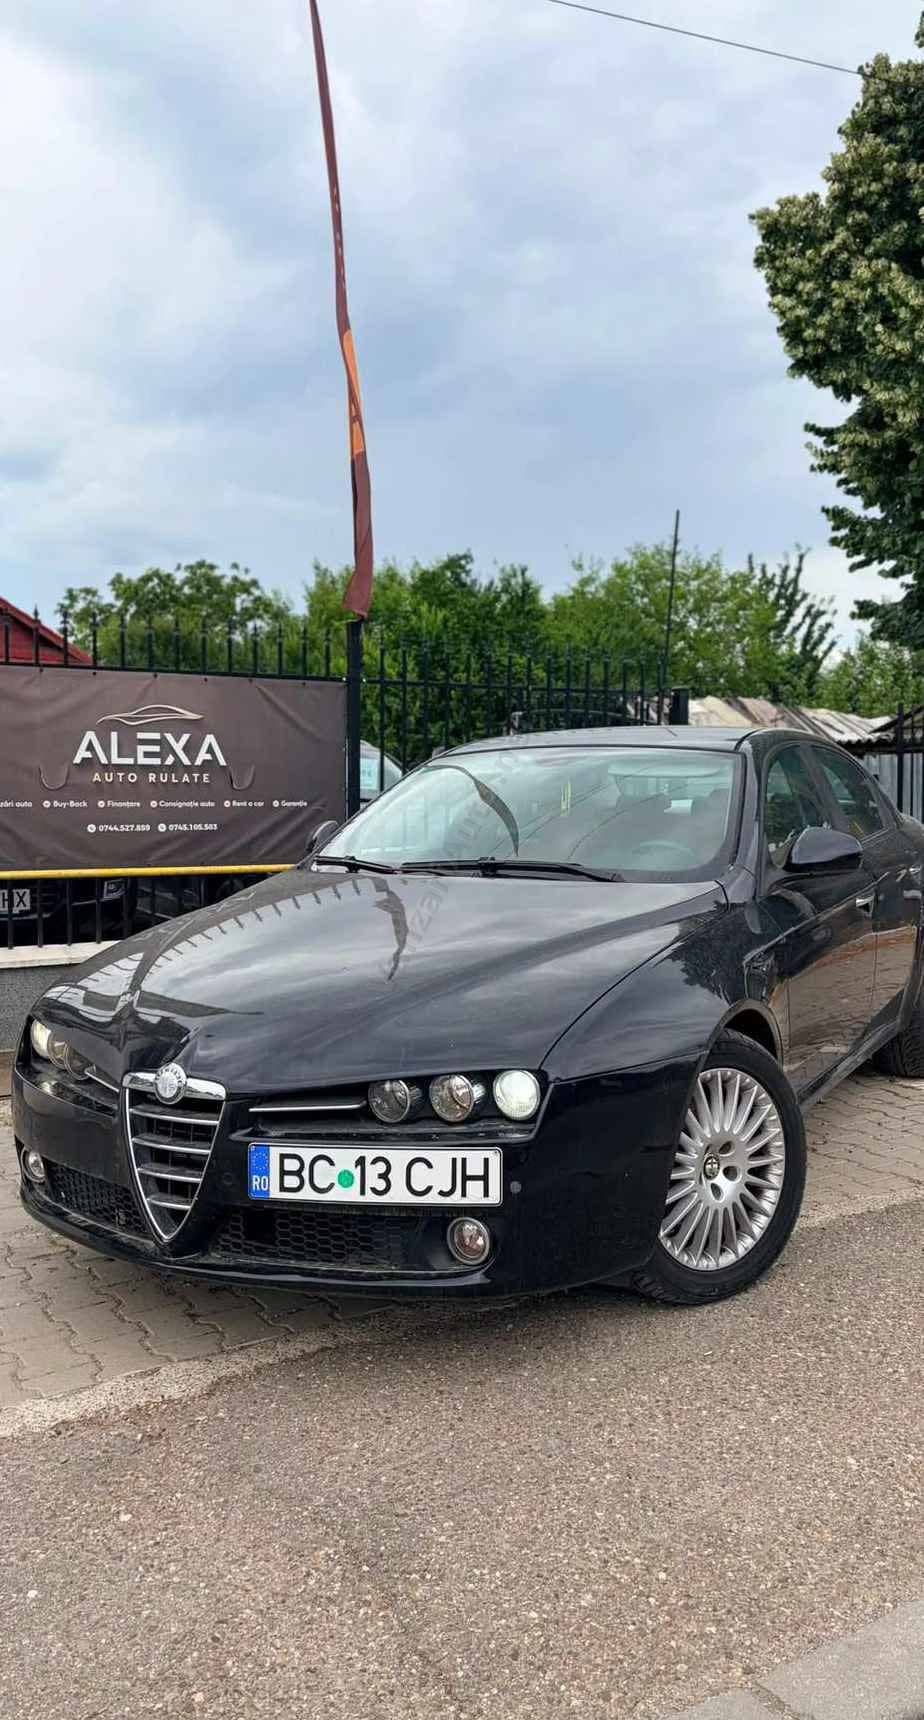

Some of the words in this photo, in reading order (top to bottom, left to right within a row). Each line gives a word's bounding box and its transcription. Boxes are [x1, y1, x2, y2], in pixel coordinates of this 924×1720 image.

[73, 731, 227, 766] ALEXA
[92, 772, 138, 783] AUTO
[149, 772, 210, 783] RULATE
[53, 800, 88, 809] Buy-Back
[252, 1175, 269, 1191] RO
[278, 1152, 336, 1194] BC
[354, 1155, 392, 1197] 13
[405, 1156, 490, 1198] CJH
